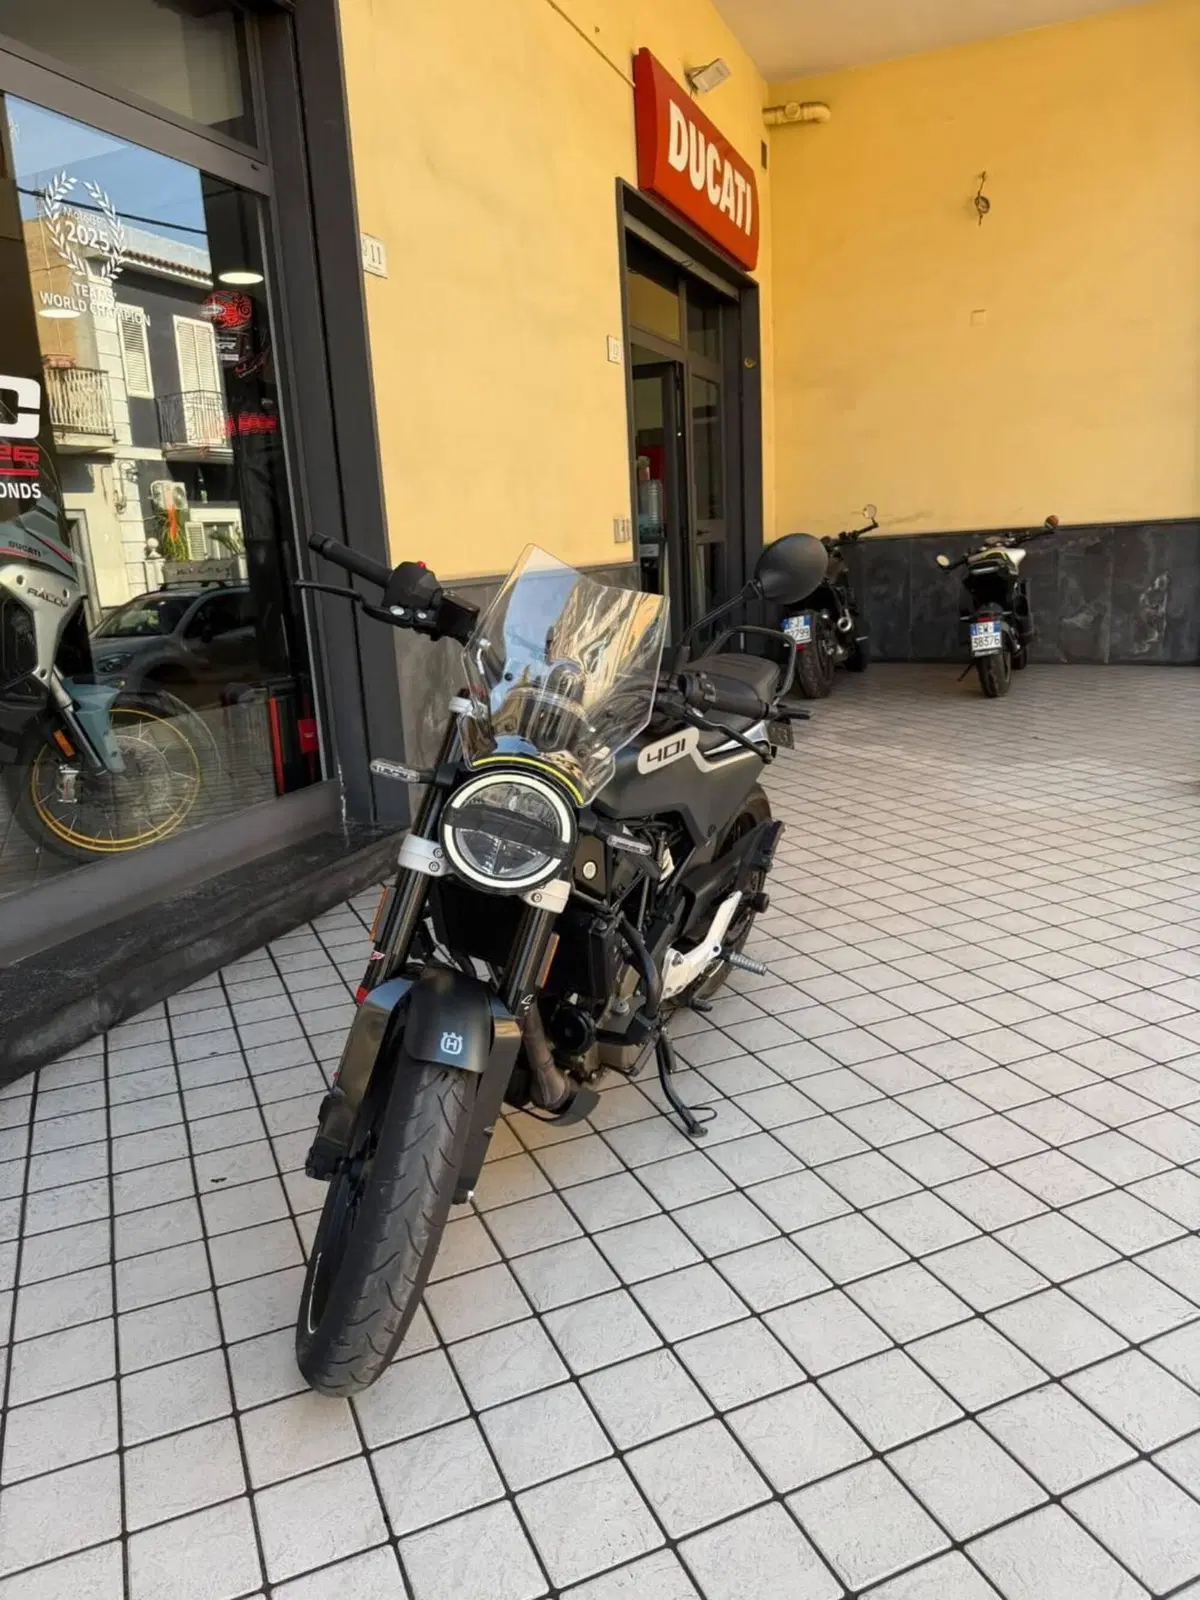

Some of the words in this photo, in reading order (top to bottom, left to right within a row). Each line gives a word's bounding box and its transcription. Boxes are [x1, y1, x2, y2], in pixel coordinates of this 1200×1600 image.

[667, 99, 752, 237] DUCATI
[64, 220, 110, 251] 2025
[40, 290, 87, 313] WORLD
[27, 587, 69, 607] RALLY
[646, 737, 686, 763] 401
